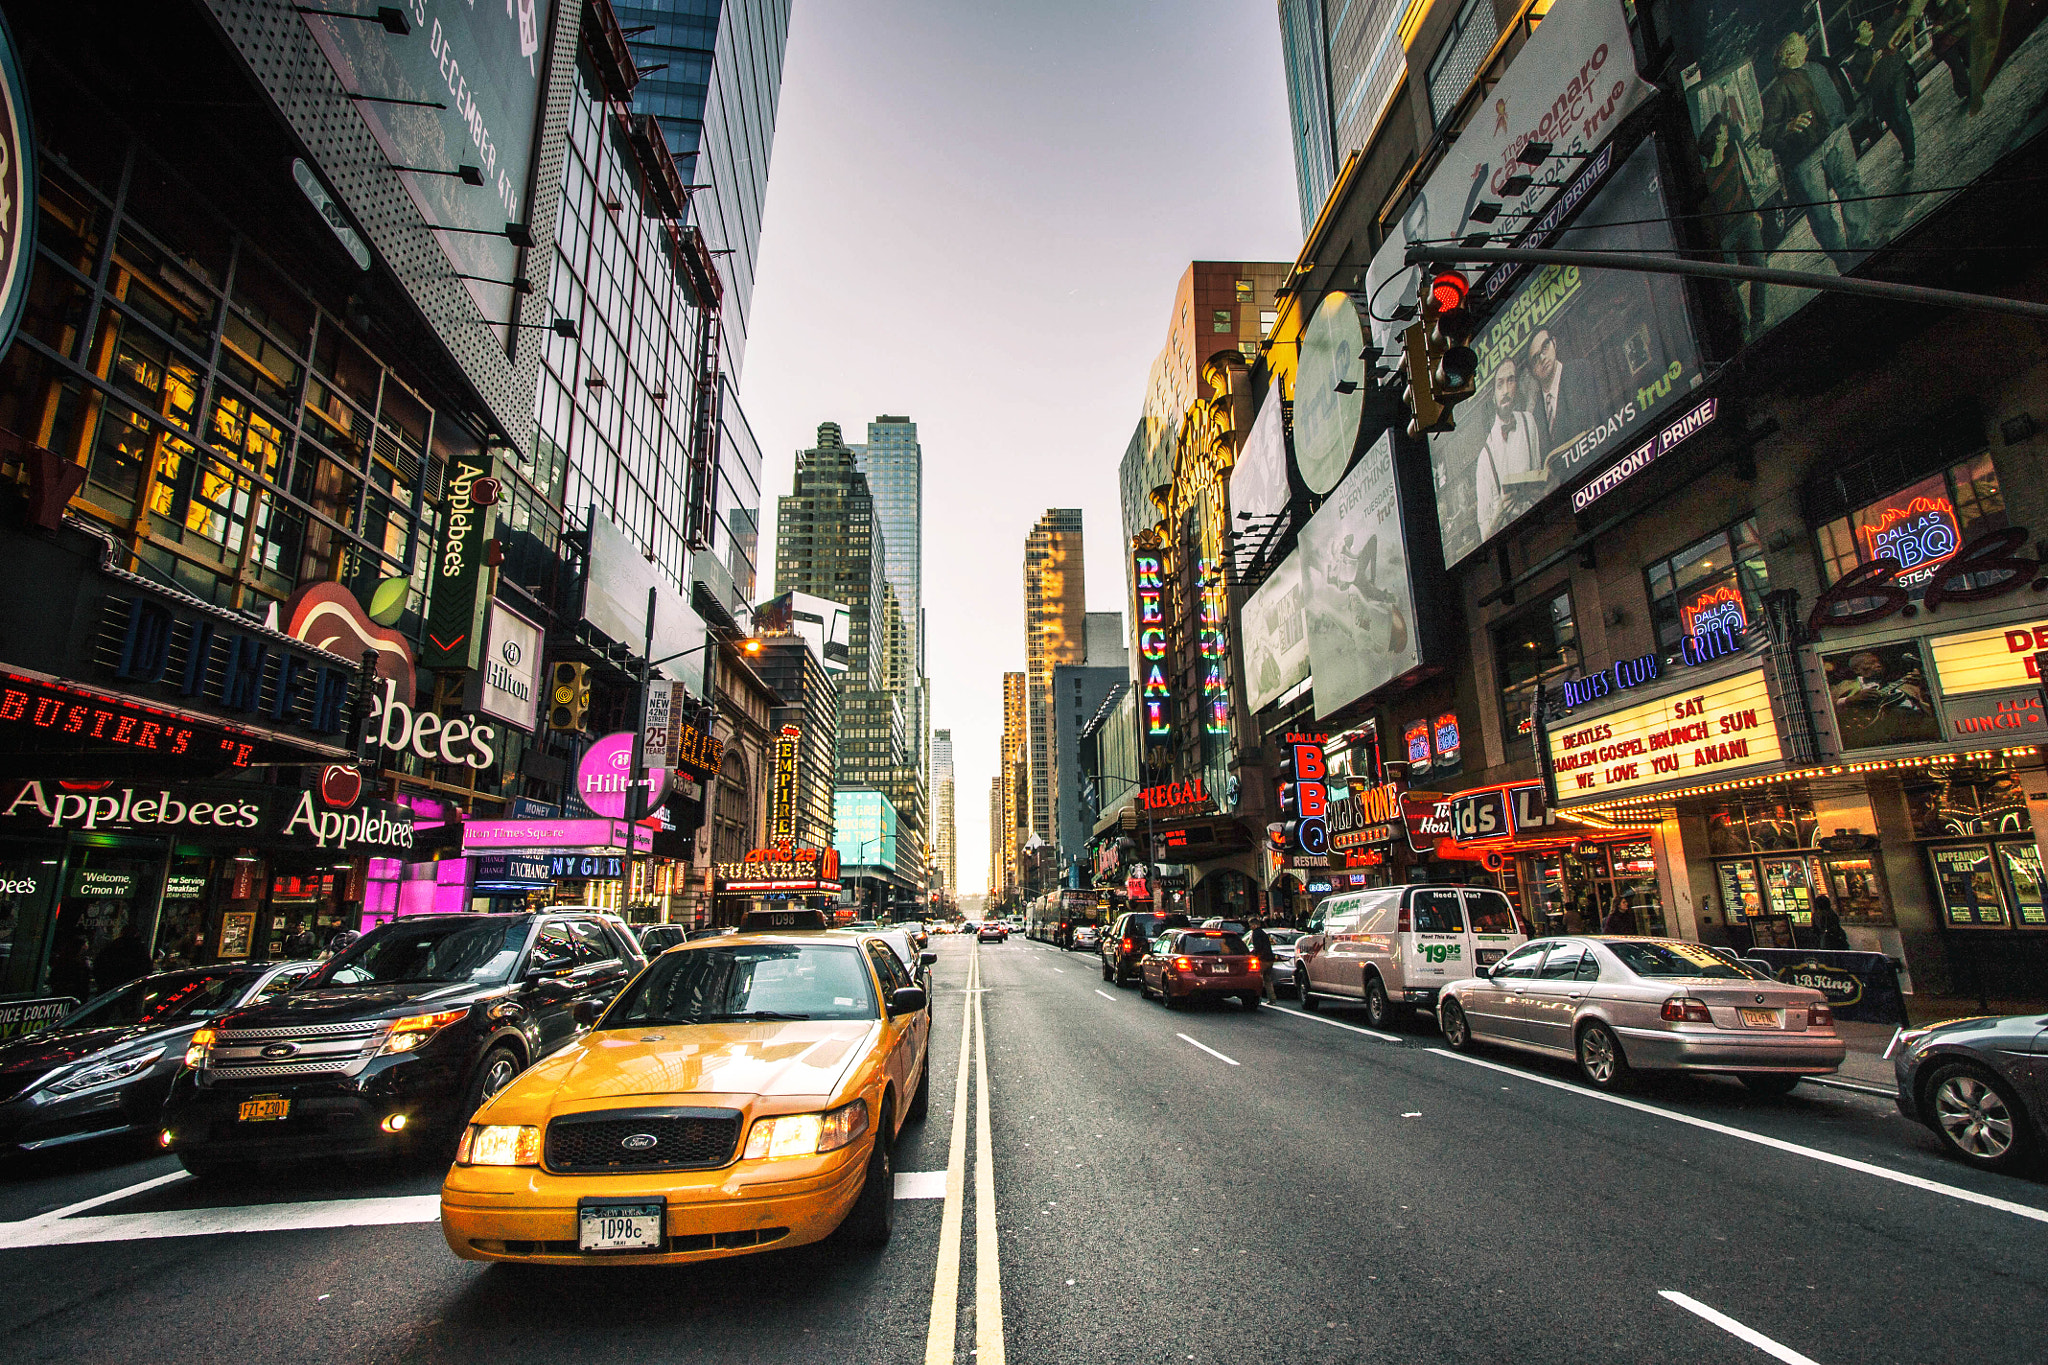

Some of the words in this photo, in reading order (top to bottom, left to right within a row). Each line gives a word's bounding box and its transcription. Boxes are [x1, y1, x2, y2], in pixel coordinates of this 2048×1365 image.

[430, 17, 496, 179] DECEMBER
[498, 168, 518, 224] 4TH
[1491, 44, 1608, 196] Cabonaro
[1496, 136, 1582, 239] WEDNESDAYS
[1562, 152, 1608, 214] PRIME
[305, 178, 360, 255] LAMAR
[1491, 264, 1563, 341] DEGREES
[1561, 402, 1637, 470] TUESDAYS
[1574, 443, 1654, 508] OUTFRONT
[1661, 401, 1714, 450] PRIME
[1338, 453, 1391, 520] EVERYTHING
[1363, 481, 1394, 518] TUESDAYS
[443, 460, 484, 577] Applebee's
[1875, 511, 1941, 547] DALLAS
[1873, 523, 1954, 569] BBQ
[1694, 600, 1736, 624] DALLAS
[1136, 557, 1170, 735] REGAL
[1563, 670, 1610, 708] BLUES
[1614, 653, 1658, 691] CLUB
[1681, 626, 1741, 667] GRILL
[487, 660, 530, 701] Hilton
[649, 699, 670, 709] NEW
[654, 691, 667, 699] THE
[1674, 695, 1706, 720] SAT
[0, 688, 193, 754] BUSTER'S
[648, 708, 668, 717] 42ND
[1954, 712, 2022, 735] LUNCH
[645, 727, 667, 748] 25
[1286, 732, 1329, 744] DALLAS
[1552, 748, 1598, 774] HARLEM
[1598, 737, 1648, 763] GOSPEL
[1648, 721, 1711, 751] BRUNCH
[1719, 708, 1759, 735] SUN
[1562, 723, 1613, 751] BEATLES
[645, 747, 666, 755] YEARS
[1576, 771, 1595, 790] WE
[1605, 762, 1640, 785] LOVE
[1650, 753, 1681, 776] YOU
[1693, 738, 1751, 768] ANANI
[585, 773, 656, 793] Hiltn
[778, 743, 793, 833] EMPIRE
[1140, 778, 1209, 810] REGAL
[2, 780, 260, 829] Applebee's
[525, 803, 550, 815] MONEY
[1294, 744, 1328, 856] BBQ
[1324, 797, 1352, 833] COLD
[1354, 781, 1400, 828] STONE
[283, 790, 414, 849] Applebee's
[492, 828, 524, 838] Times
[526, 828, 564, 840] Square
[1335, 826, 1388, 848] CREAMERY
[744, 847, 793, 863] amc
[794, 848, 817, 862] 25
[1293, 855, 1331, 868] RESTAUR
[1580, 845, 1598, 854] Lids
[1937, 849, 1986, 863] APPEARING
[510, 861, 550, 880] EXCHANGE
[551, 857, 576, 876] NY
[717, 861, 817, 879] THEATRES
[1951, 861, 1975, 873] NEXT
[81, 884, 112, 895] C'mon
[166, 884, 200, 893] Breakfast
[180, 876, 205, 887] Serving
[770, 913, 795, 926] 1D98
[630, 1137, 649, 1147] Ford
[600, 1209, 620, 1218] NEW
